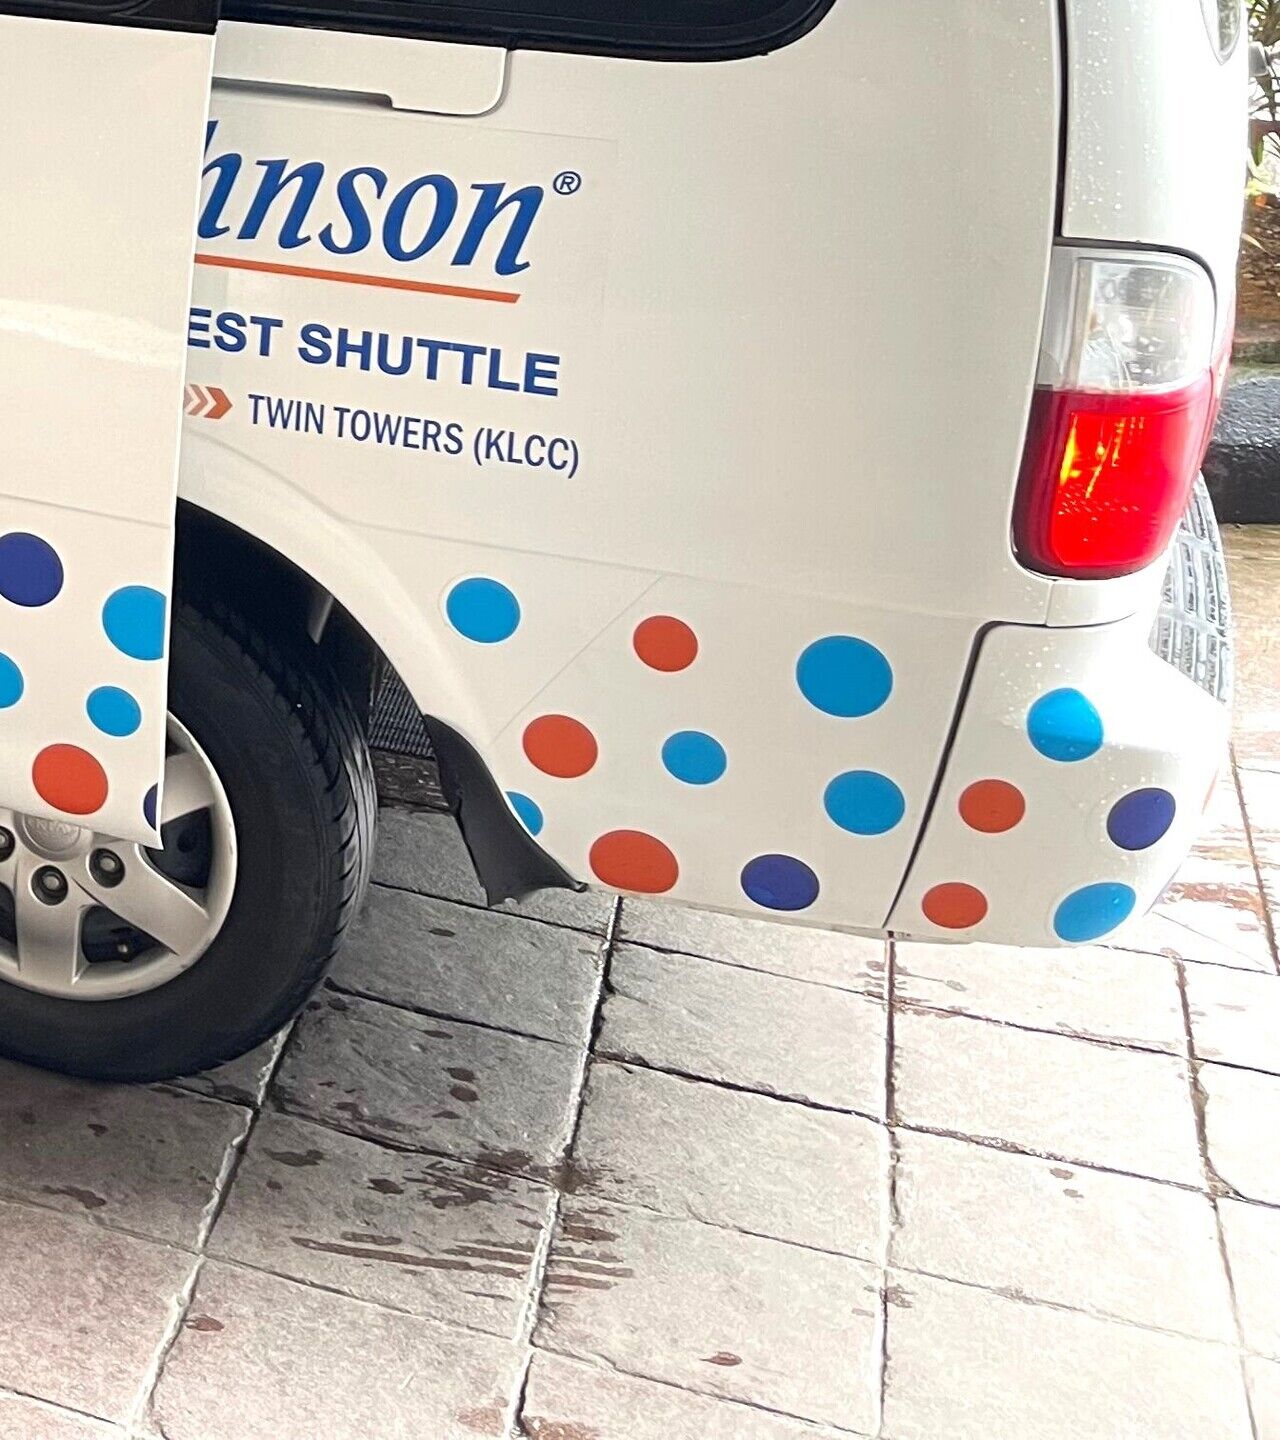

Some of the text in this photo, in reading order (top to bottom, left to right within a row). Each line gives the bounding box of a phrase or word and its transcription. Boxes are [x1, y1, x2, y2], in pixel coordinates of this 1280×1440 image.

[297, 322, 561, 397] SHUTTLE
[248, 393, 580, 479] TWIN TOWERS (KLCC)
